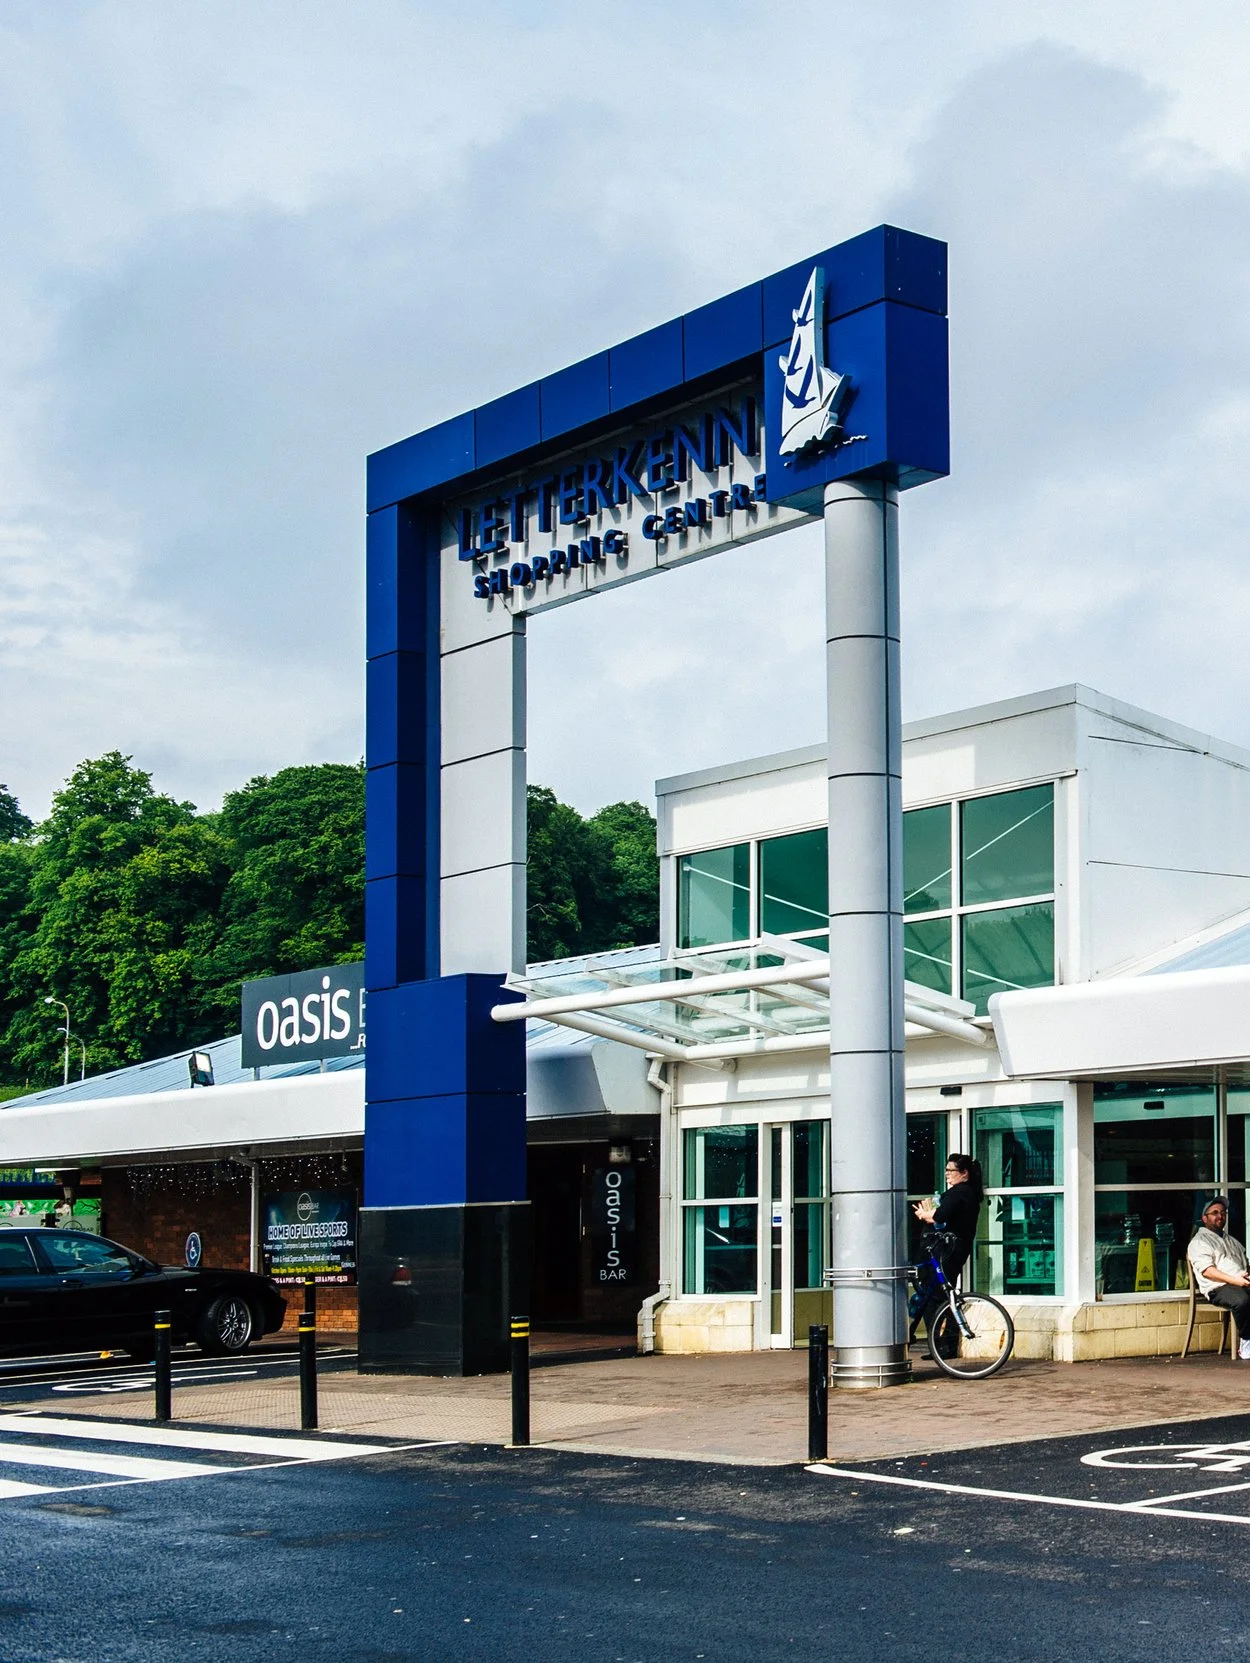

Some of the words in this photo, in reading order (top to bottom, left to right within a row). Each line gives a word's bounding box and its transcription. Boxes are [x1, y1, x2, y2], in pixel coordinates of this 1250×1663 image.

[458, 394, 762, 561] LETTERKENN
[474, 528, 627, 599] SHOPPING
[642, 474, 765, 540] CENTRE
[257, 975, 351, 1050] oasis
[268, 1225, 289, 1240] HOME
[290, 1223, 301, 1239] OF
[301, 1222, 320, 1239] LIVE
[320, 1221, 348, 1238] SPORTS
[599, 1269, 627, 1281] BAR
